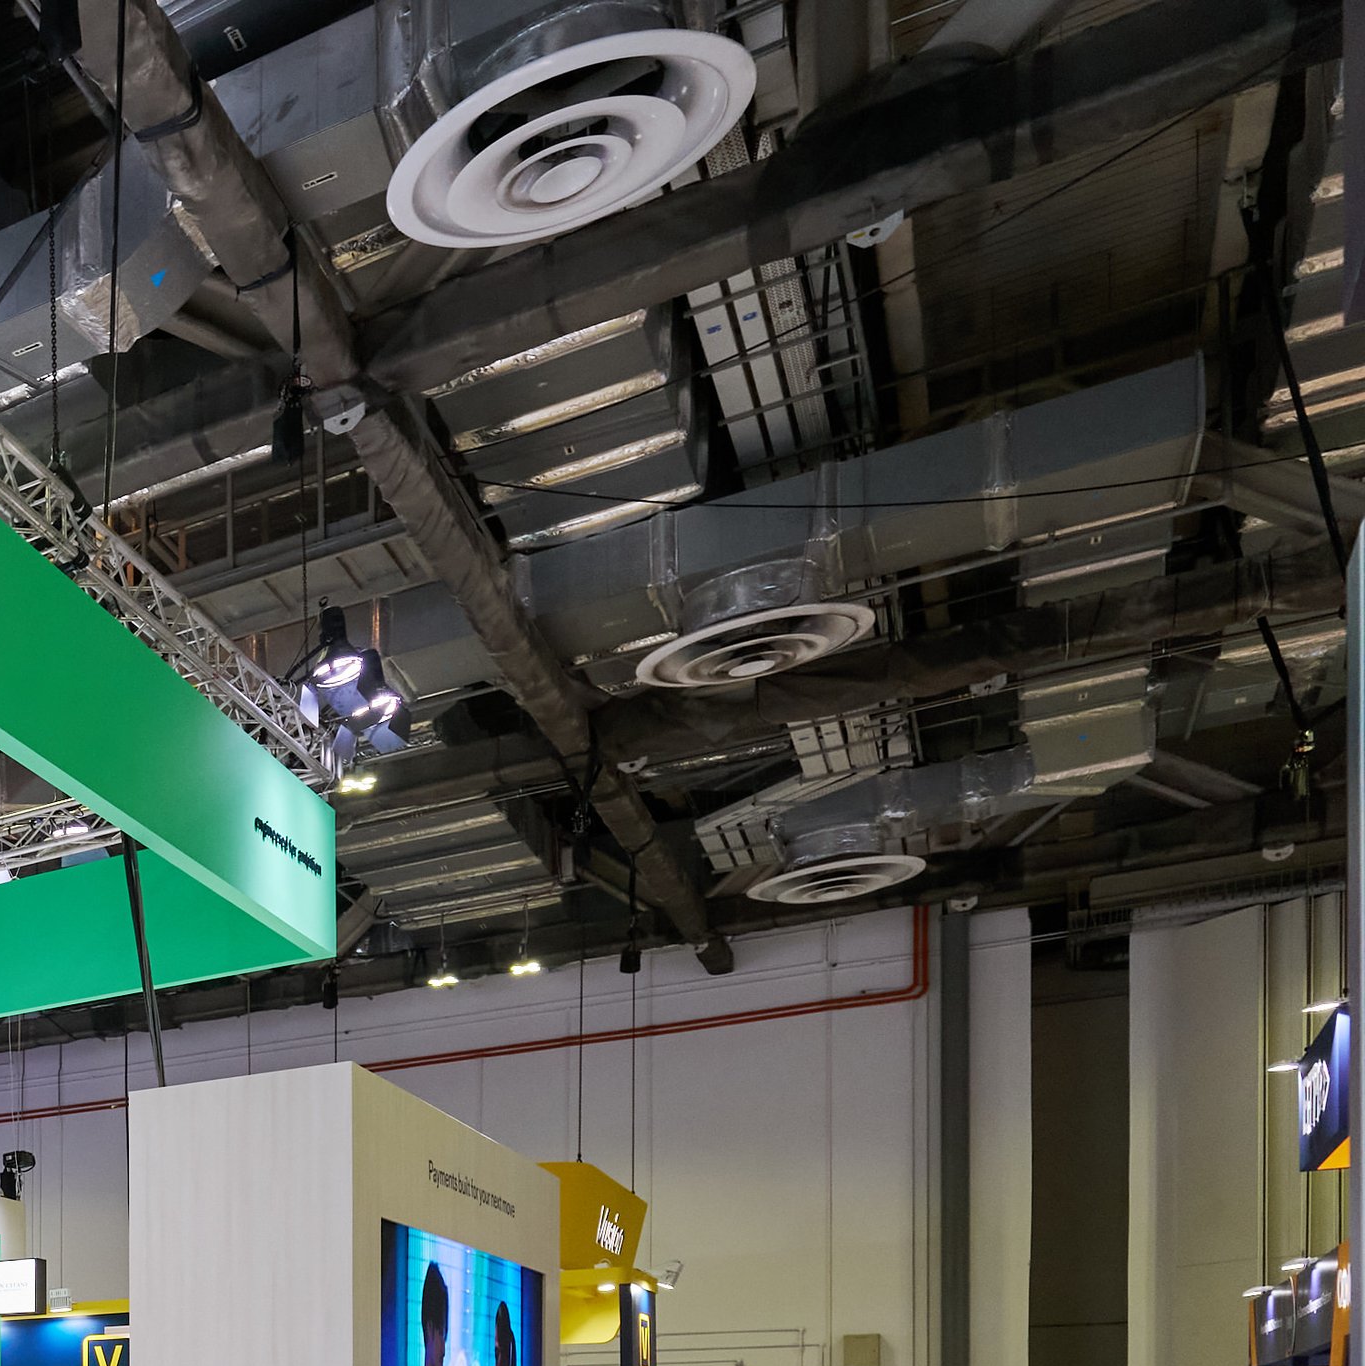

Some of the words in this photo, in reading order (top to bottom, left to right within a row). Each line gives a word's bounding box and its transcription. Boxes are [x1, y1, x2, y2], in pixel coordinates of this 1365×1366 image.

[428, 1160, 458, 1192] Payments
[458, 1173, 471, 1198] built
[471, 1179, 479, 1198] for
[479, 1188, 491, 1206] your
[491, 1193, 502, 1210] next
[502, 1201, 516, 1218] move
